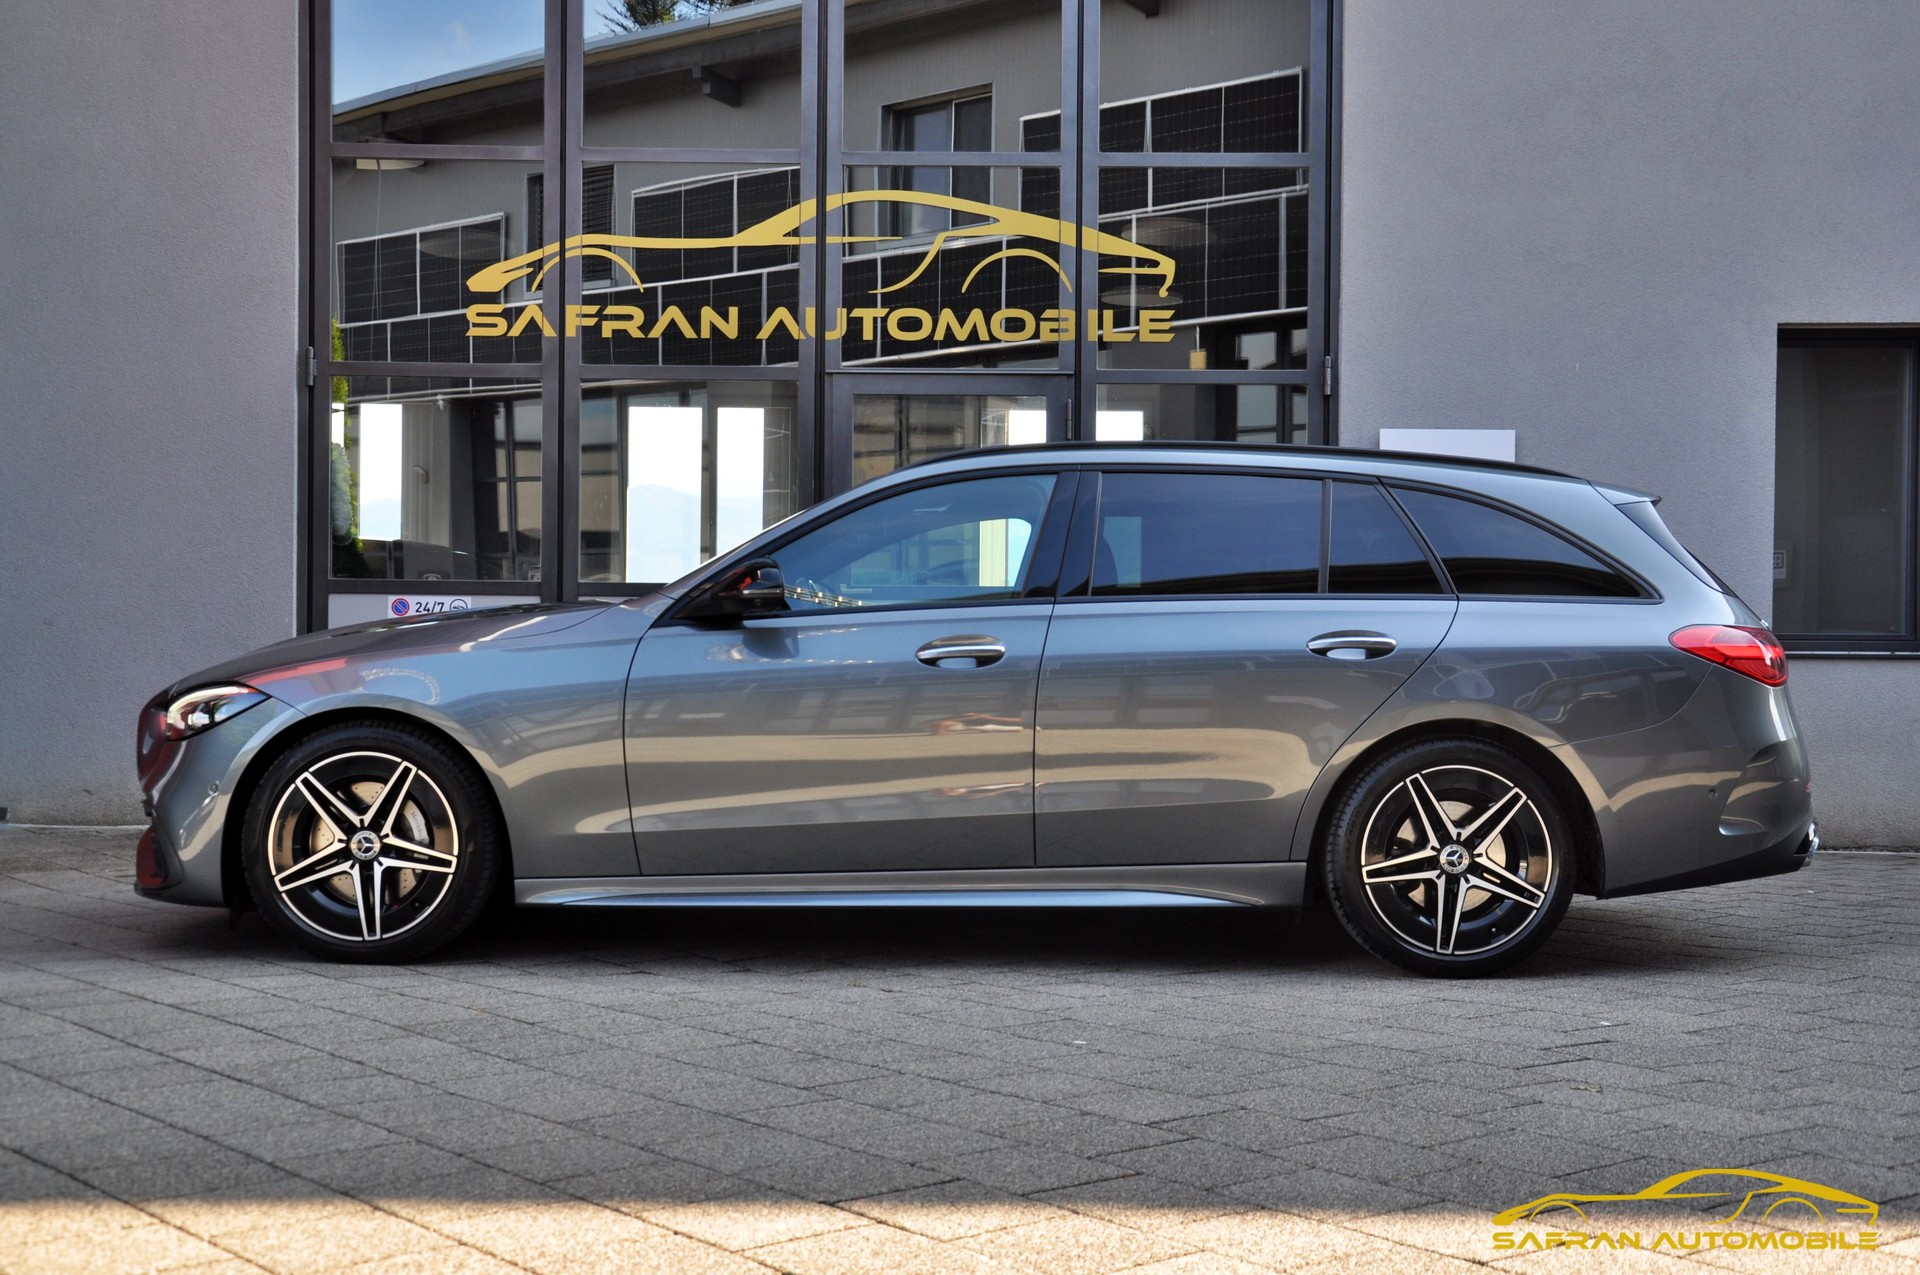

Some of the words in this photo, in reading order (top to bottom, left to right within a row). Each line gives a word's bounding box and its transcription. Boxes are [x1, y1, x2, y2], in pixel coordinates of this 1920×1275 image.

[466, 304, 739, 339] SAFRAN
[756, 305, 1175, 342] AUTOMOBILE
[415, 601, 445, 613] 24/7
